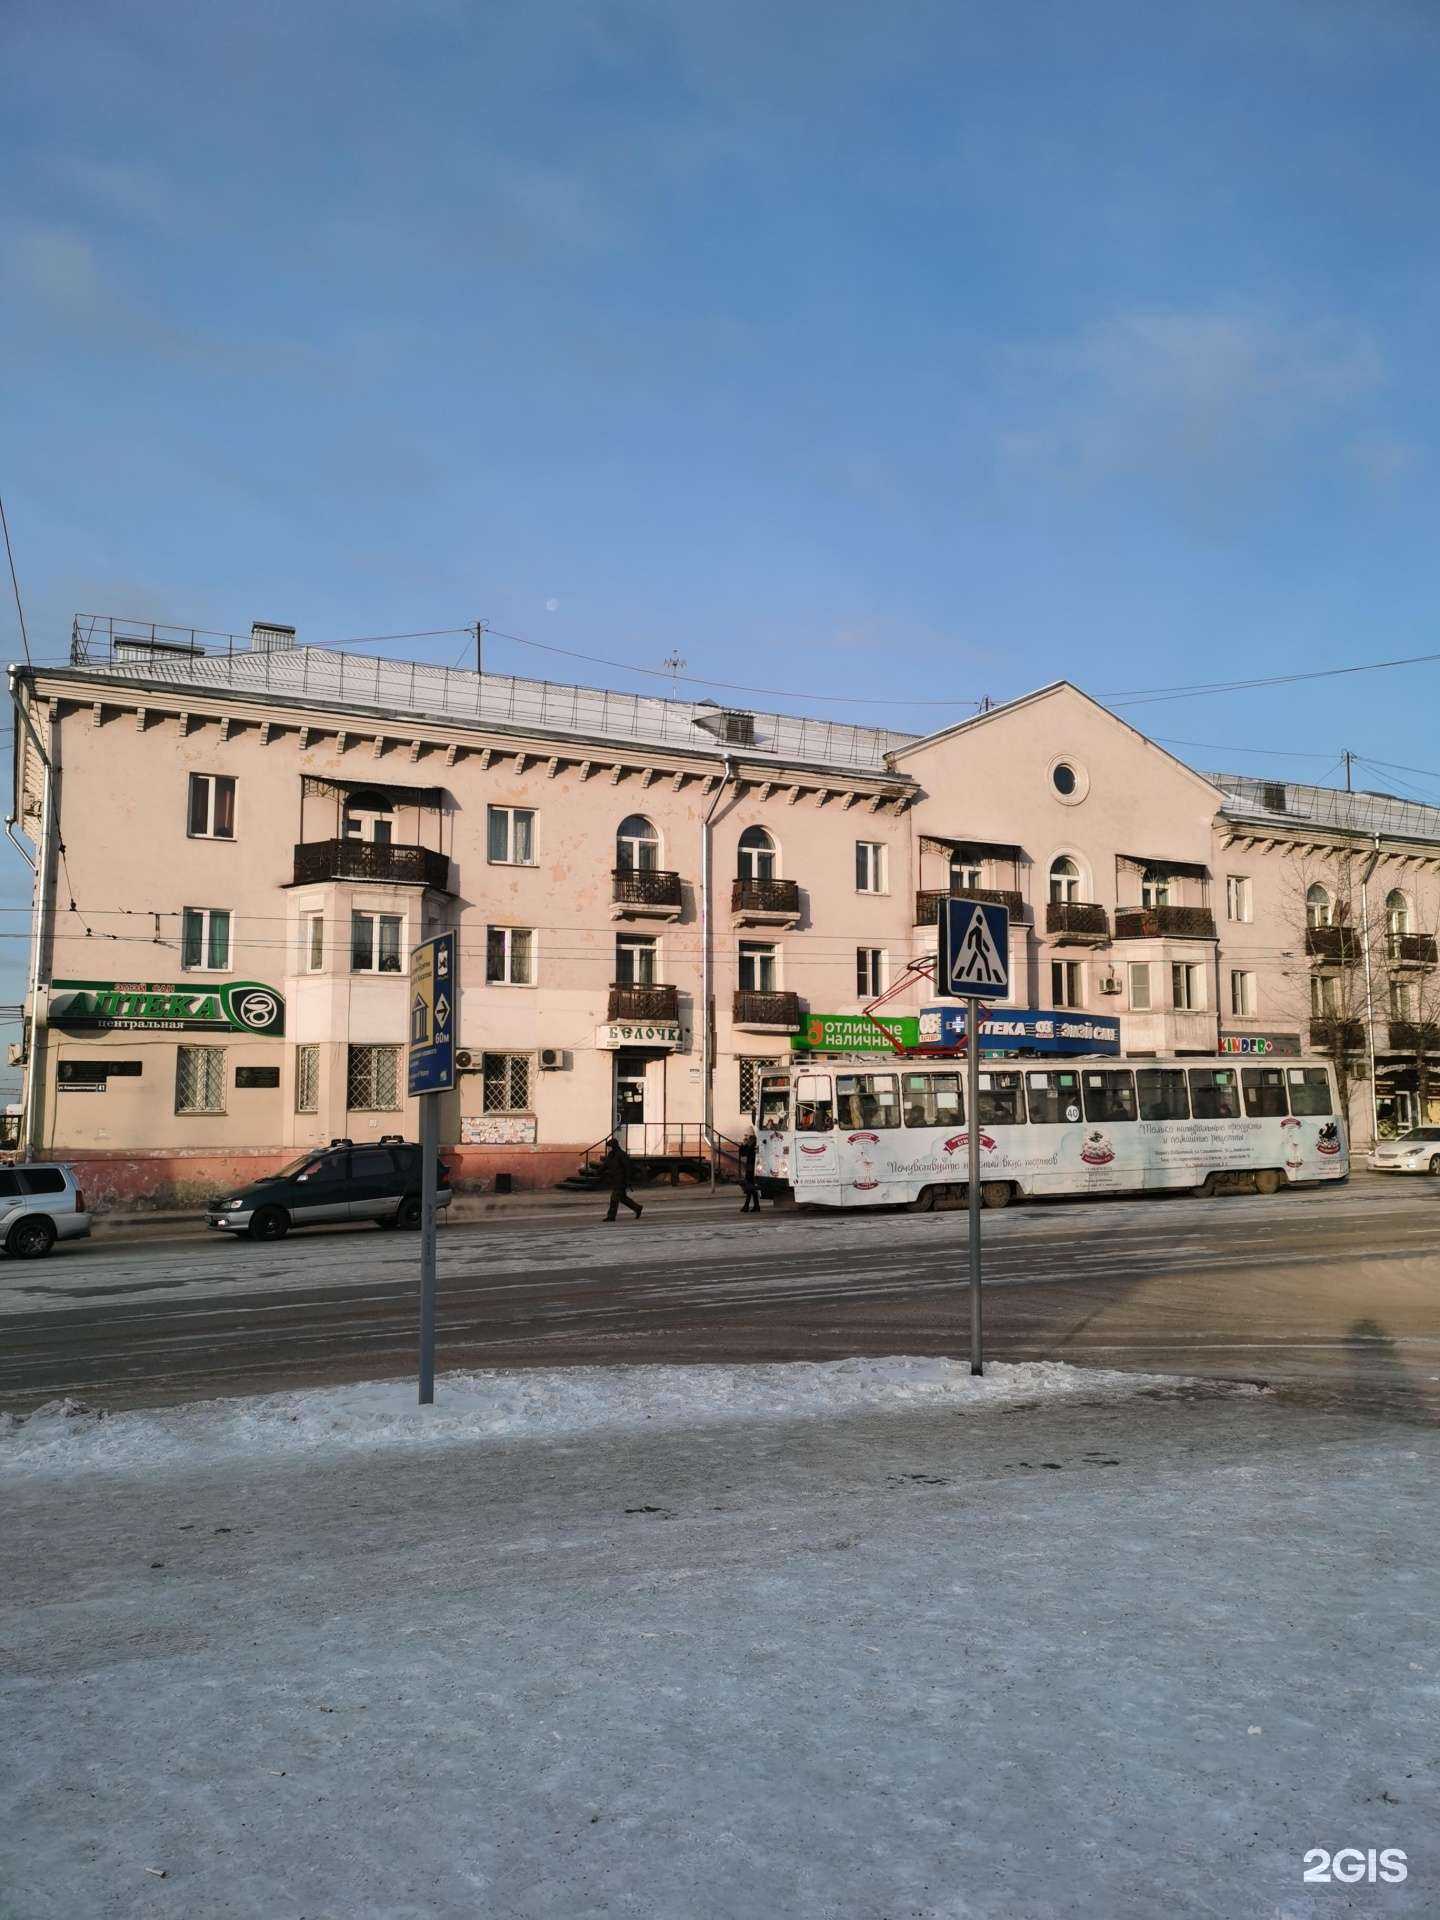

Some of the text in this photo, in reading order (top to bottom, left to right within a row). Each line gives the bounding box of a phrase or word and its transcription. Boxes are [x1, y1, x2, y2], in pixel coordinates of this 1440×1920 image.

[63, 992, 217, 1018] АПТЕКА
[98, 1019, 184, 1029] центральная
[824, 1022, 903, 1035] отличные
[968, 1021, 1025, 1036] ПТЕКА
[1217, 1037, 1266, 1054] KINDER
